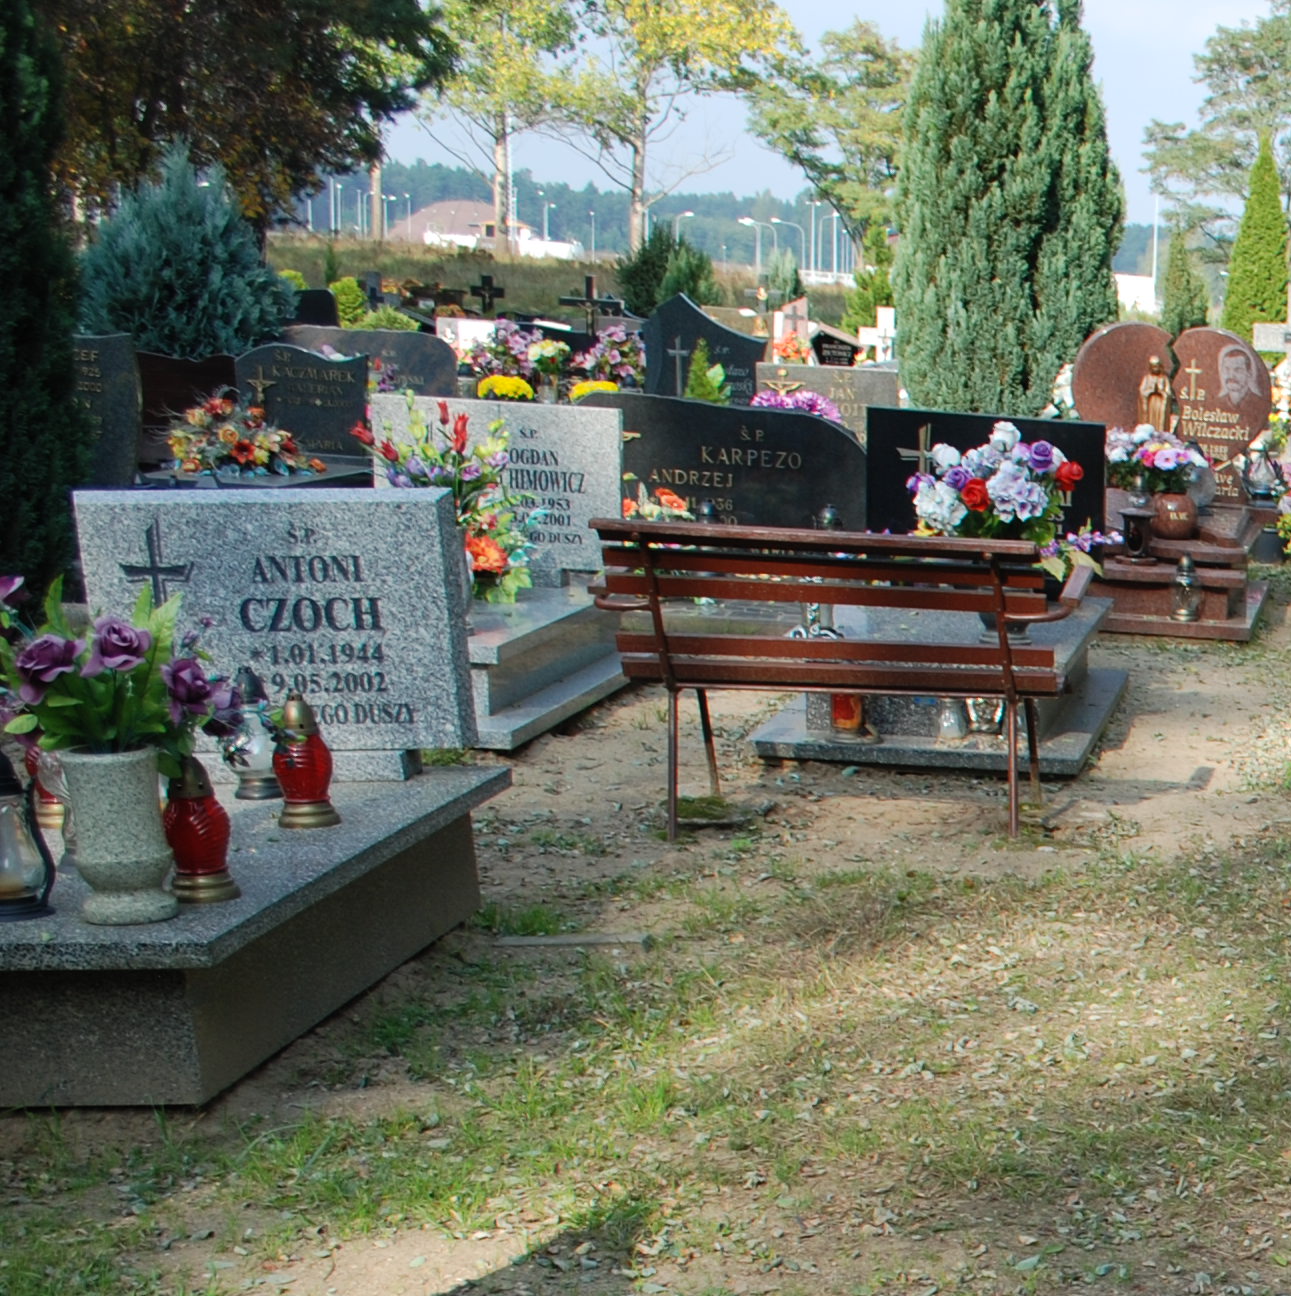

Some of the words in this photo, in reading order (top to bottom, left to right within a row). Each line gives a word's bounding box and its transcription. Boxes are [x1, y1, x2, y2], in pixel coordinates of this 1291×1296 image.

[508, 448, 559, 467] OGDAN
[701, 446, 802, 470] KARPEZO
[506, 469, 586, 494] HIMOWICZ
[650, 468, 734, 488] ANDRZEJ
[252, 555, 366, 584] ANTONI
[239, 597, 387, 633] CZOCH
[353, 703, 415, 725] DUSZY
